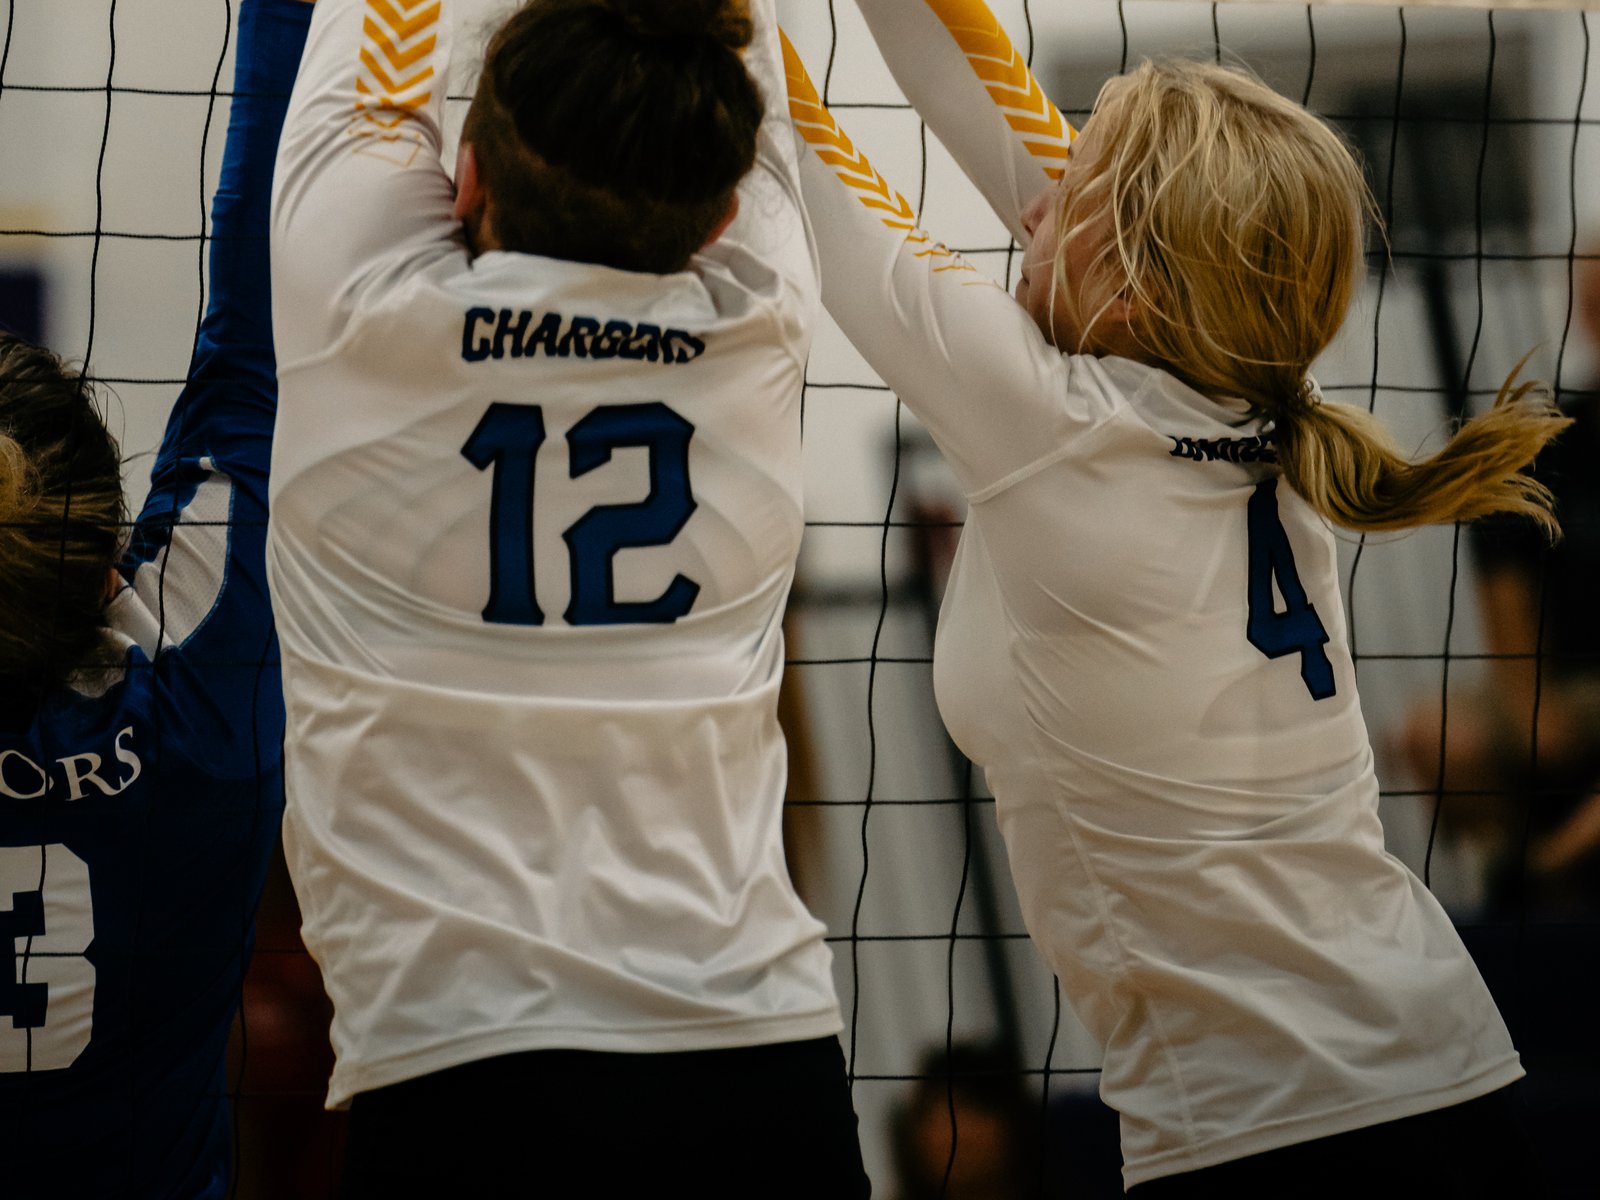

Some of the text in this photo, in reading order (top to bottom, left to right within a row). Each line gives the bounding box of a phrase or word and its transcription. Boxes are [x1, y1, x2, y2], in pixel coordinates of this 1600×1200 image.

[460, 401, 701, 626] 12
[1246, 479, 1337, 701] 4
[0, 726, 142, 802] ORS
[0, 842, 96, 1073] 3
